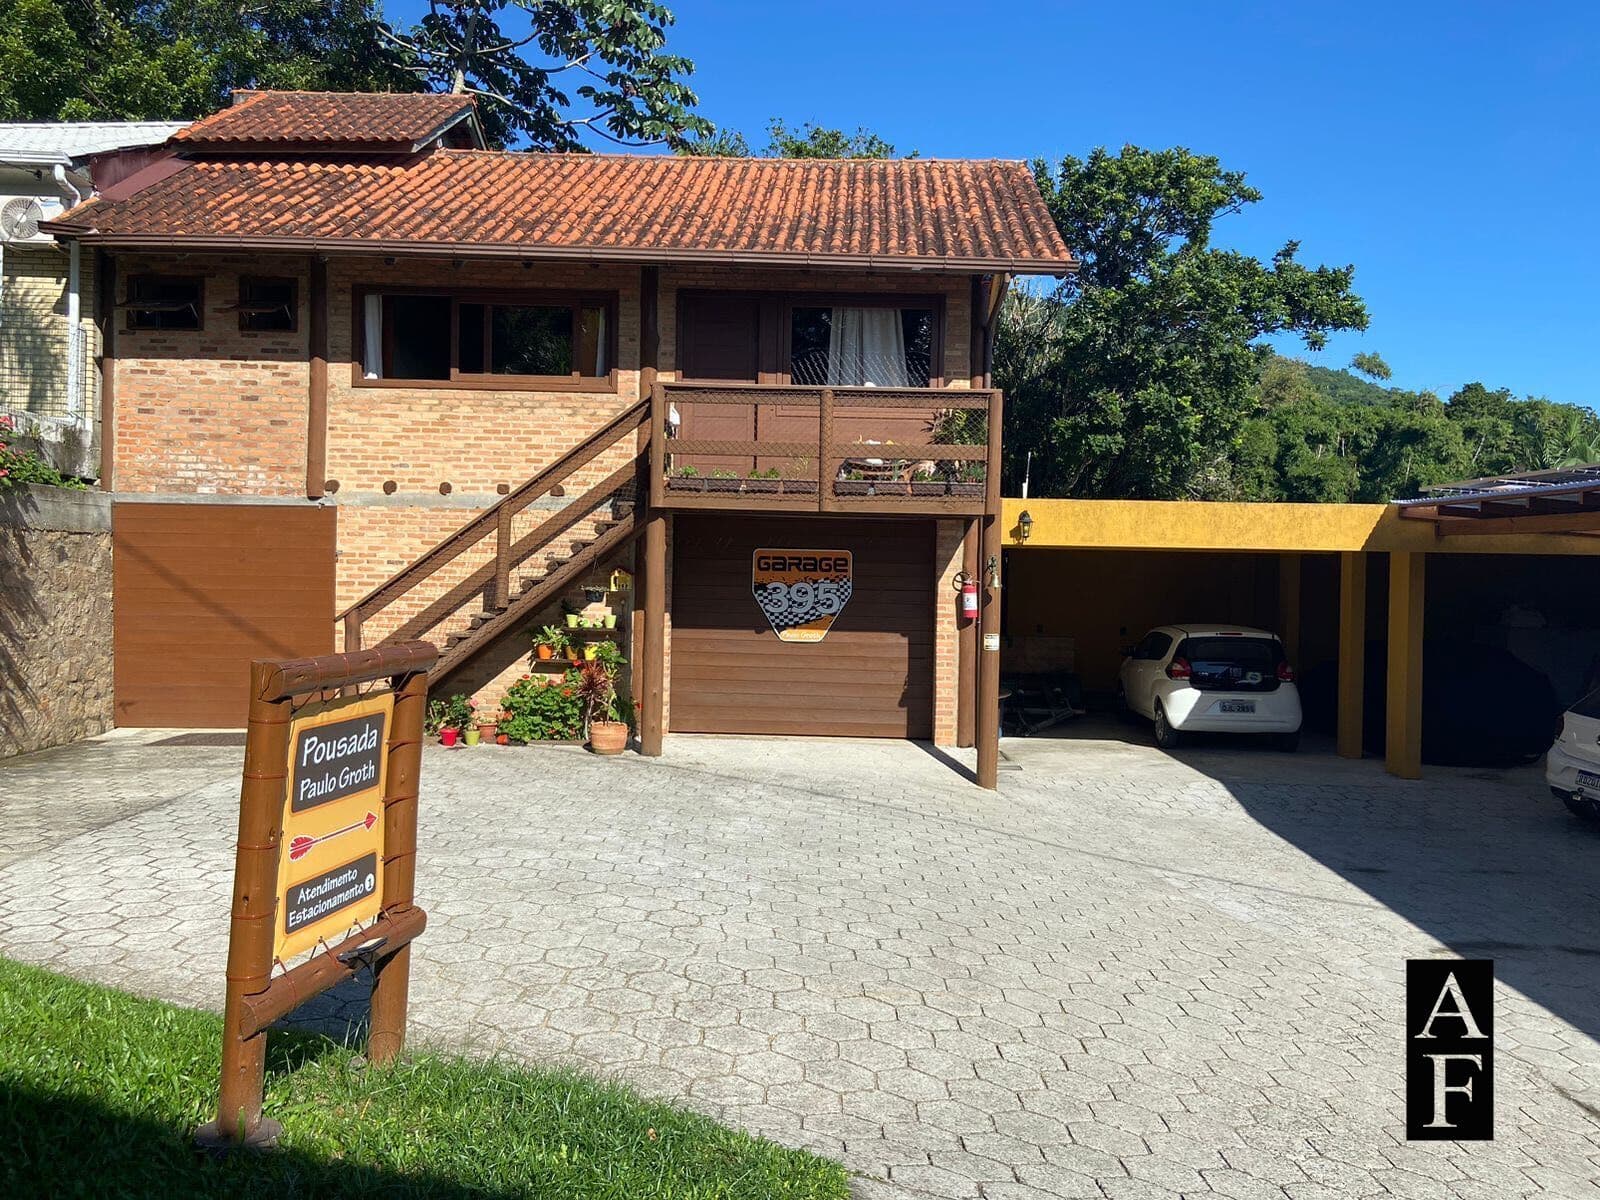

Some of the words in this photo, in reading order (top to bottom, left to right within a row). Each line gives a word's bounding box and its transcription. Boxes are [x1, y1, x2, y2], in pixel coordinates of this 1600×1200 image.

[764, 582, 841, 614] 395
[302, 723, 378, 767] Pousada
[300, 772, 336, 801] Paulo
[339, 759, 375, 789] Groth
[288, 883, 364, 928] Estacionamento
[297, 869, 358, 905] Atendimento
